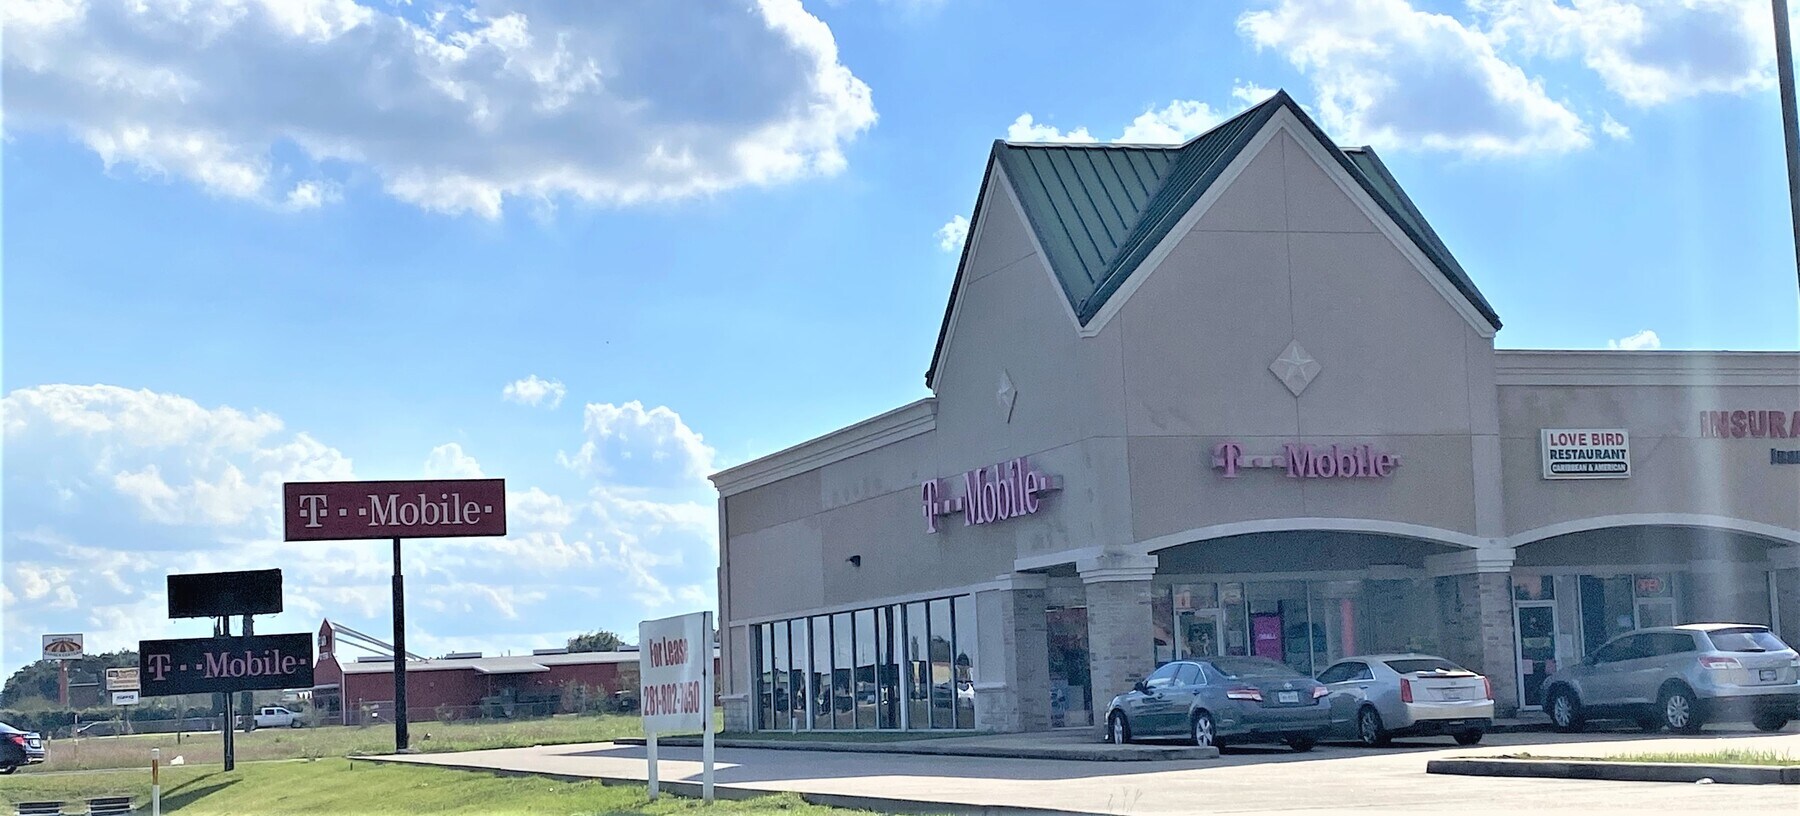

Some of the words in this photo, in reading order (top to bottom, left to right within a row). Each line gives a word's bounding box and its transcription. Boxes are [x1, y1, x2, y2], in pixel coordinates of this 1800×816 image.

[1549, 449, 1626, 460] RESTAURANT
[1550, 433, 1587, 446] LOVE
[1591, 433, 1624, 446] BIRD
[1283, 442, 1393, 478] Mobile
[1594, 463, 1626, 471] AMERICAN
[963, 457, 1040, 527] Mobile
[368, 493, 481, 527] Mobile
[204, 649, 297, 679] Mobile
[649, 638, 663, 668] For
[663, 636, 688, 667] Lease
